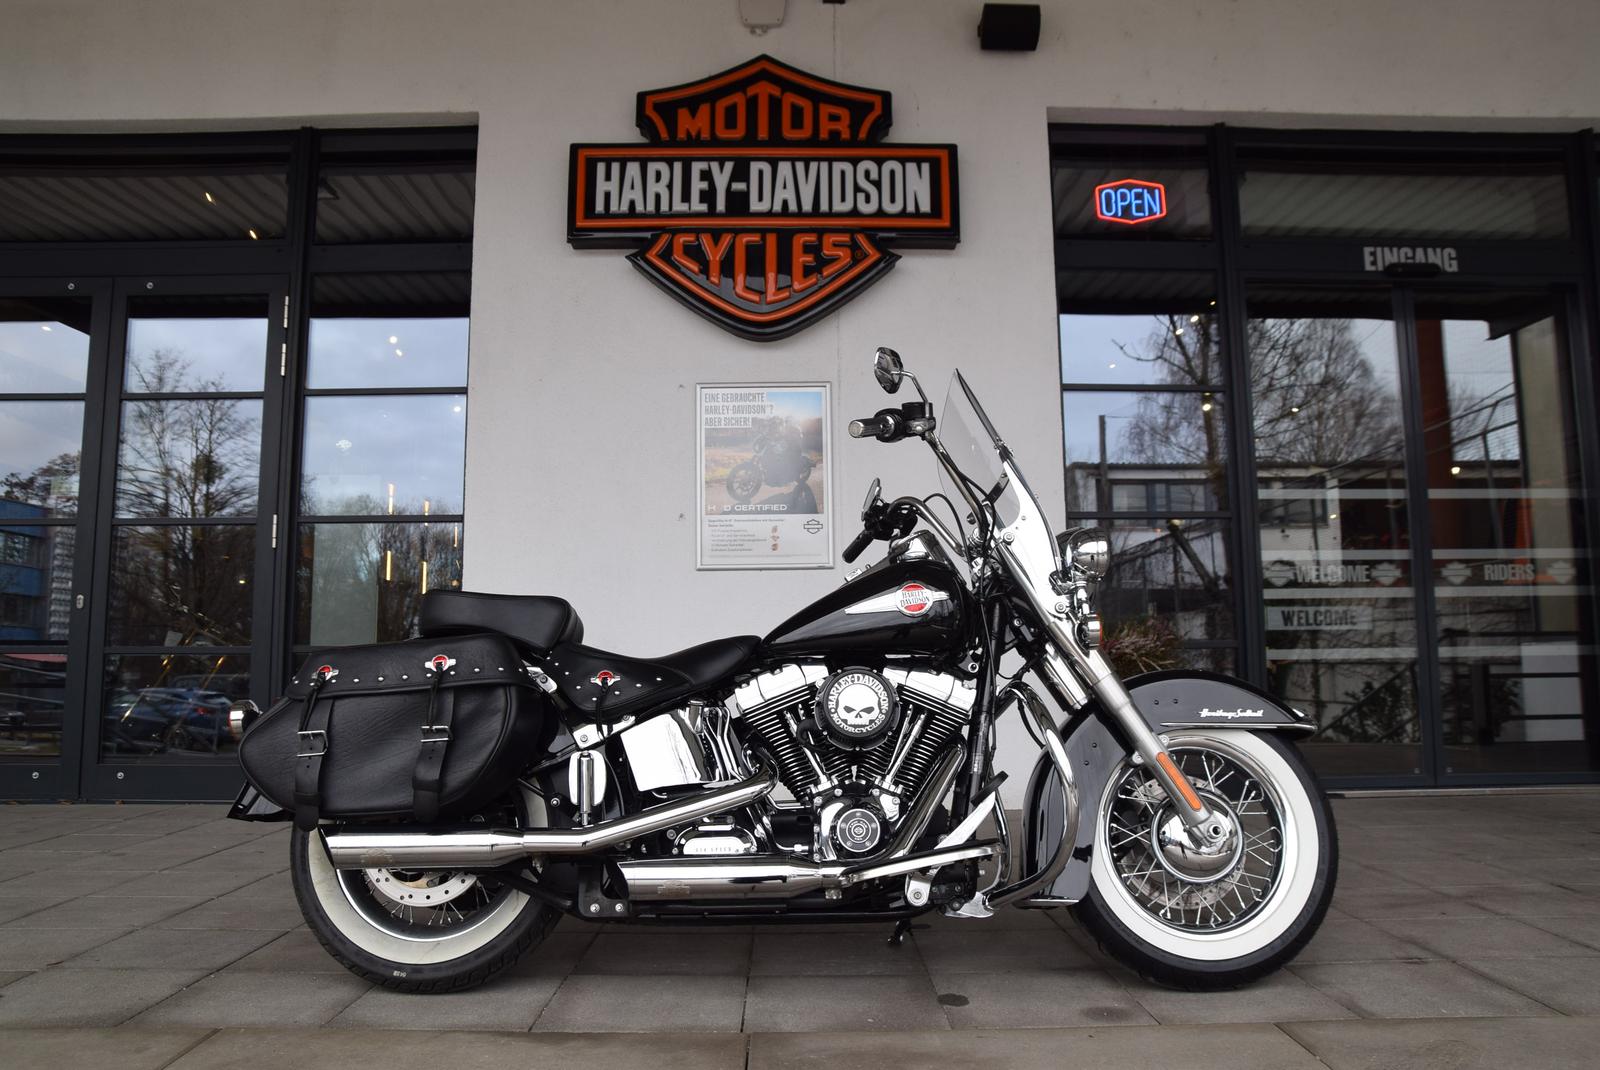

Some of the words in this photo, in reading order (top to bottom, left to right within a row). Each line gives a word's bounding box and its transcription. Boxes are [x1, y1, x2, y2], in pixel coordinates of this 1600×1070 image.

[676, 80, 851, 141] MOTOR
[595, 160, 932, 214] HARLEY-DAVIDSON
[1101, 188, 1161, 217] OPEN
[672, 232, 852, 305] CYCLES
[704, 393, 720, 403] EINE
[721, 392, 765, 402] GEBRAUCHTE
[704, 417, 722, 427] ABER
[723, 417, 751, 427] SICHER!
[1296, 565, 1371, 583] WELCOME
[1484, 564, 1535, 580] RIDERS
[1281, 609, 1358, 627] WELCOME
[828, 673, 889, 711] HARLEY-DAVIDSON
